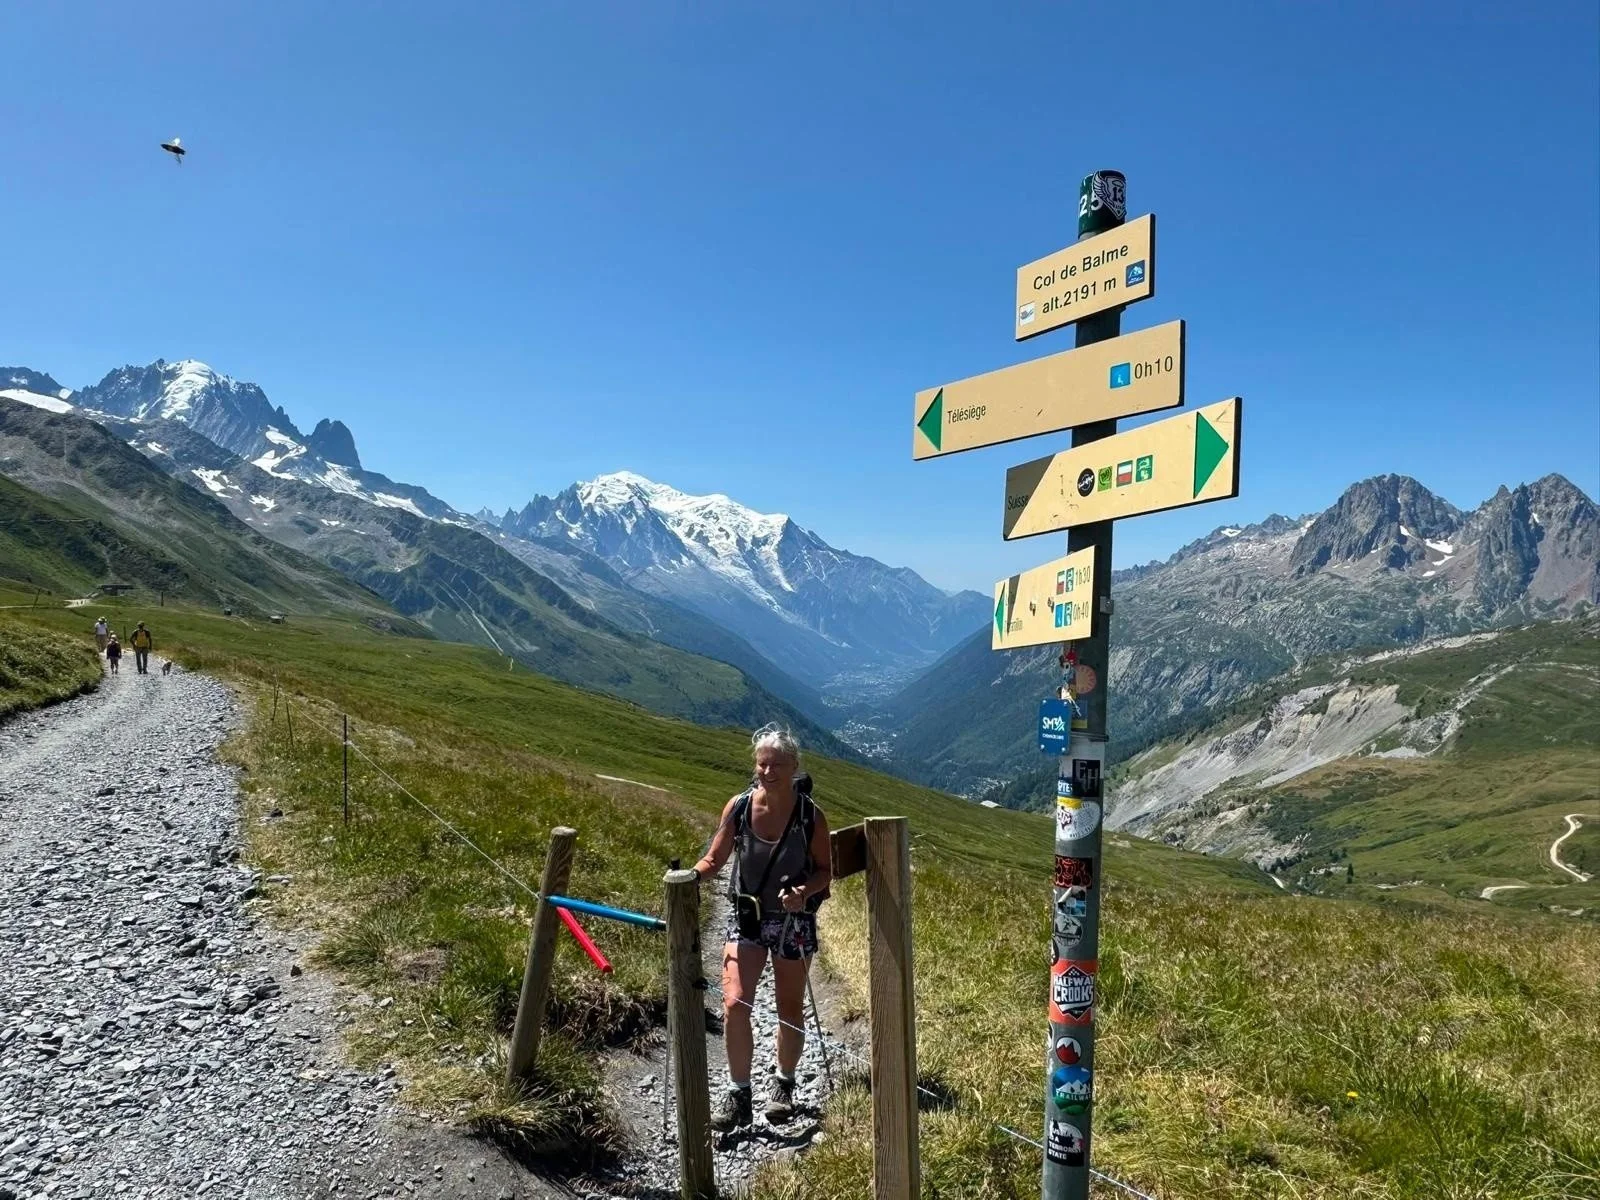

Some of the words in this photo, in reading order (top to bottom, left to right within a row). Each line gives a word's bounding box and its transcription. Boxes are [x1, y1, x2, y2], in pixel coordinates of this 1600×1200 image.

[1033, 270, 1055, 290] Col
[1060, 264, 1077, 280] de
[1082, 244, 1129, 273] Balme
[1042, 281, 1098, 314] alt.2191
[1103, 277, 1116, 292] m
[1134, 355, 1173, 380] 0h10
[947, 403, 987, 425] Télésiège
[1075, 566, 1091, 586] 1h30
[1073, 601, 1089, 621] 0h40
[1053, 974, 1095, 987] HALFWAY
[1053, 985, 1095, 1003] CROOKS
[1056, 1090, 1092, 1102] TRAILWA
[1048, 1147, 1068, 1160] STATE
